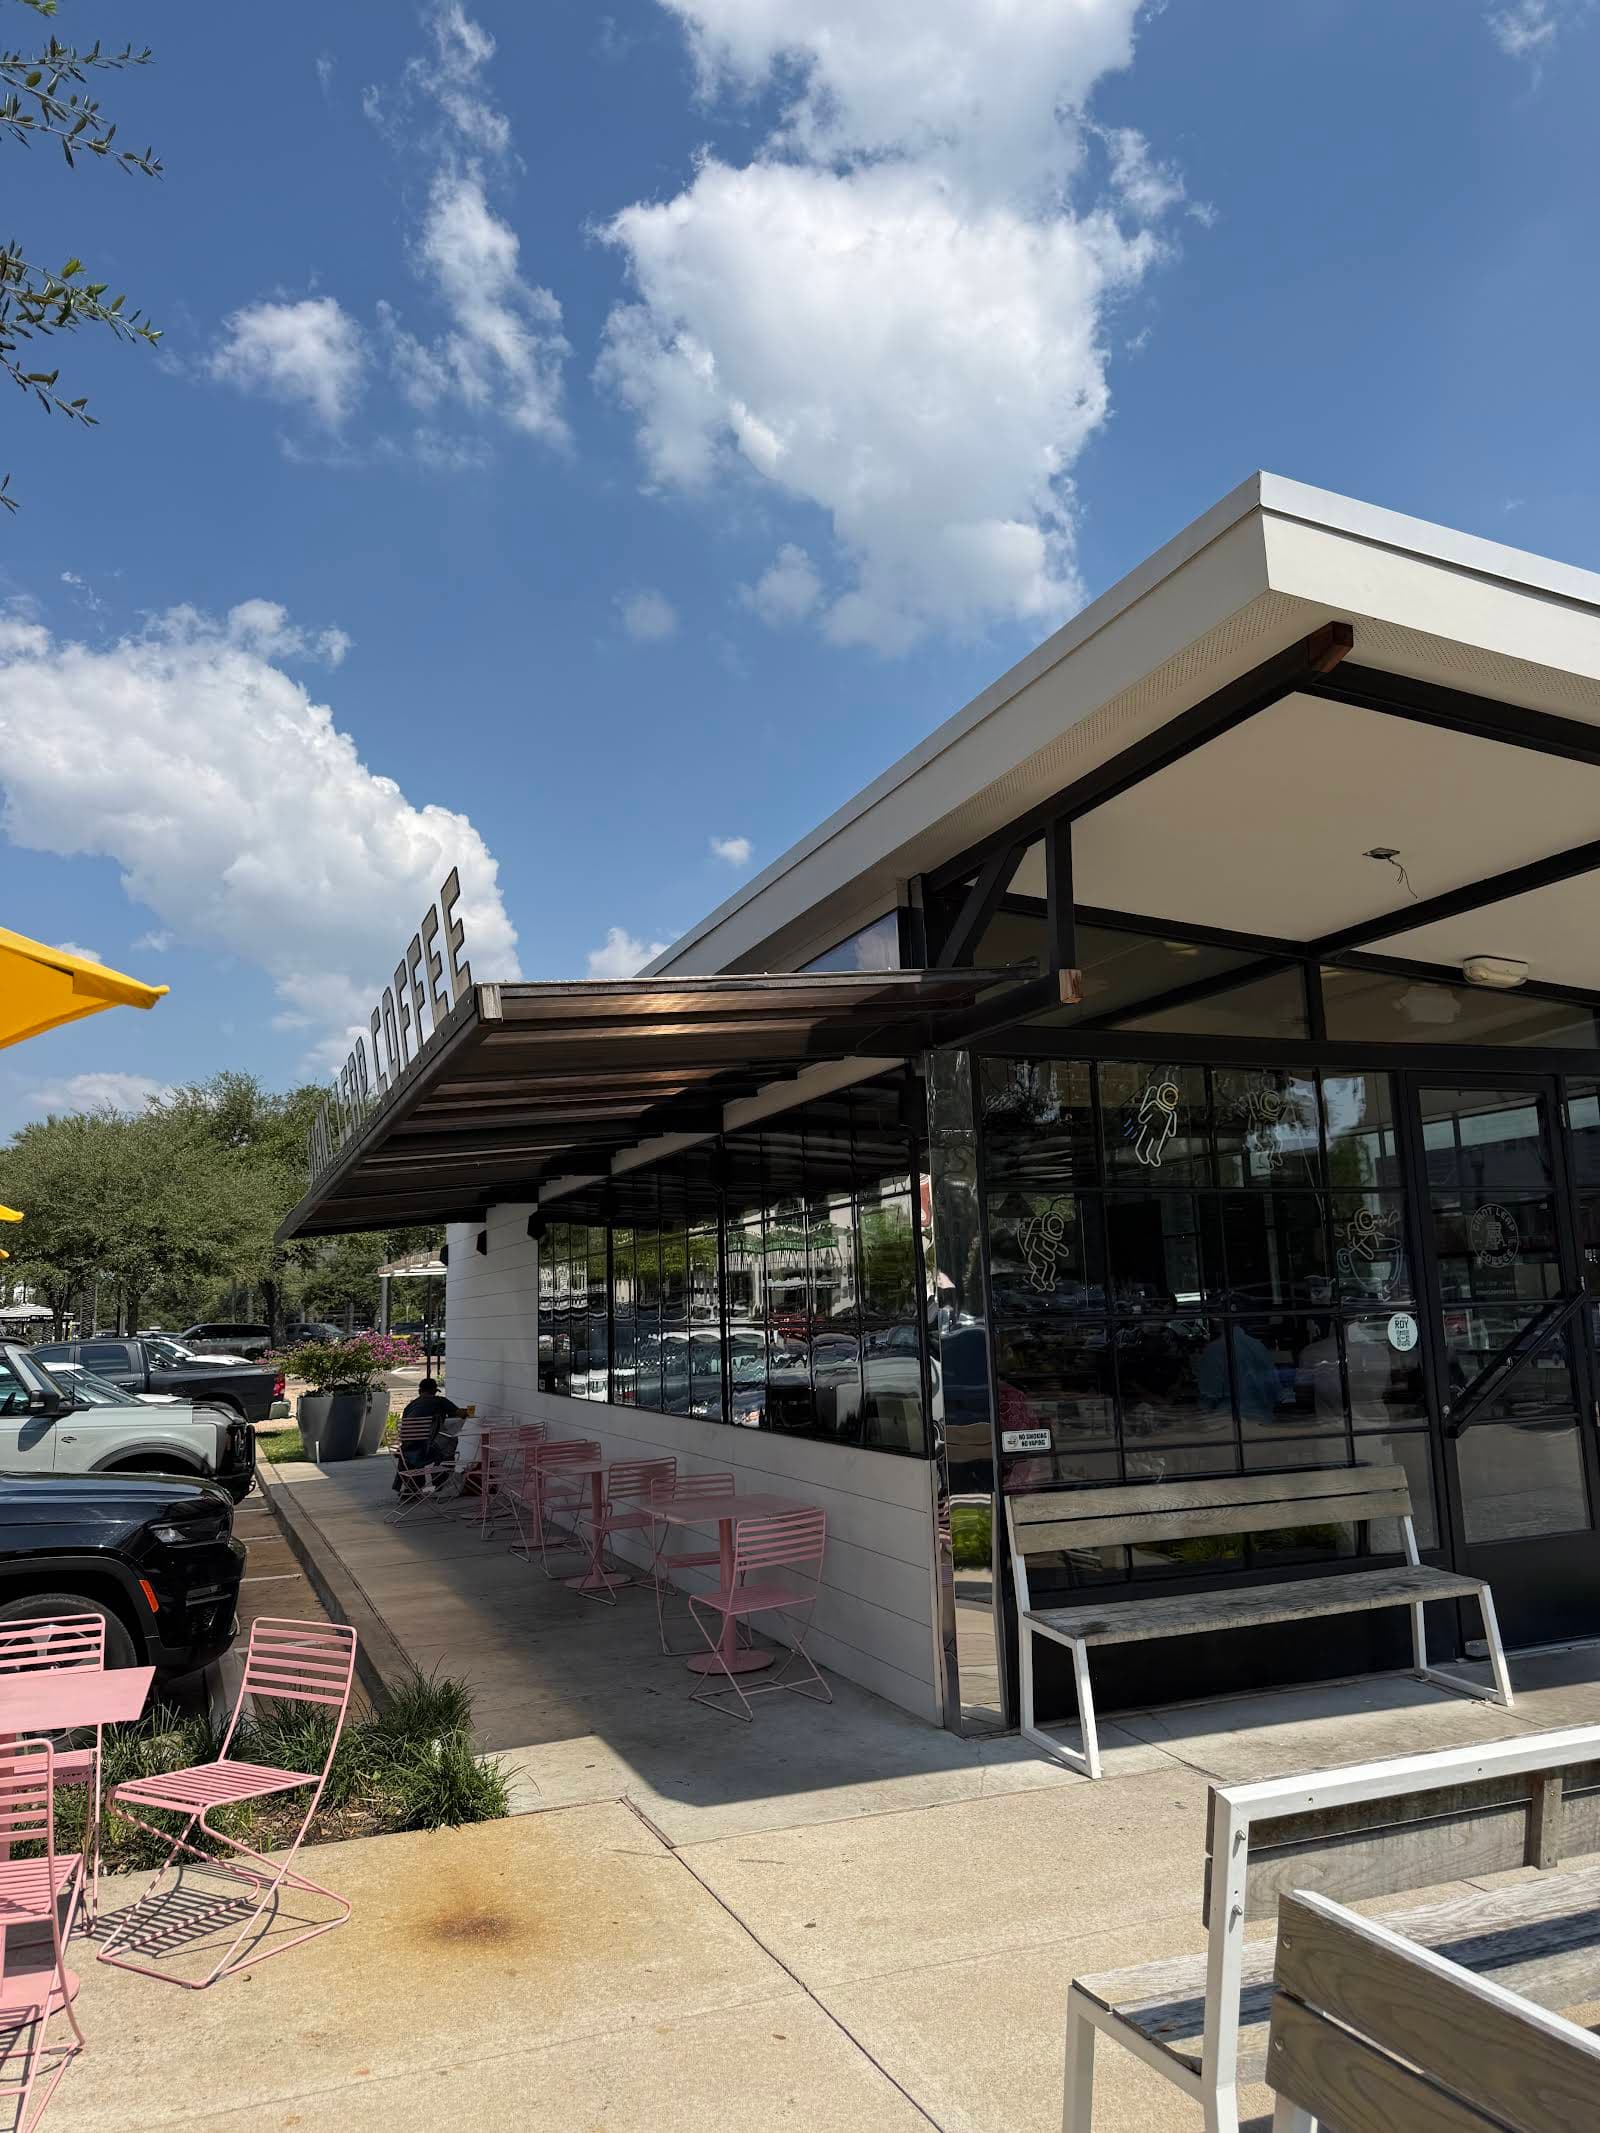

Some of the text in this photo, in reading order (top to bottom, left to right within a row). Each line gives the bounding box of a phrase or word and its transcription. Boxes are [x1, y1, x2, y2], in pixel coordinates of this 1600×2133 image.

[335, 1036, 368, 1150] LEAP
[371, 866, 472, 1095] COFFEE
[1472, 1207, 1515, 1231] GIANT LEAP
[1480, 1248, 1514, 1265] COFFEE
